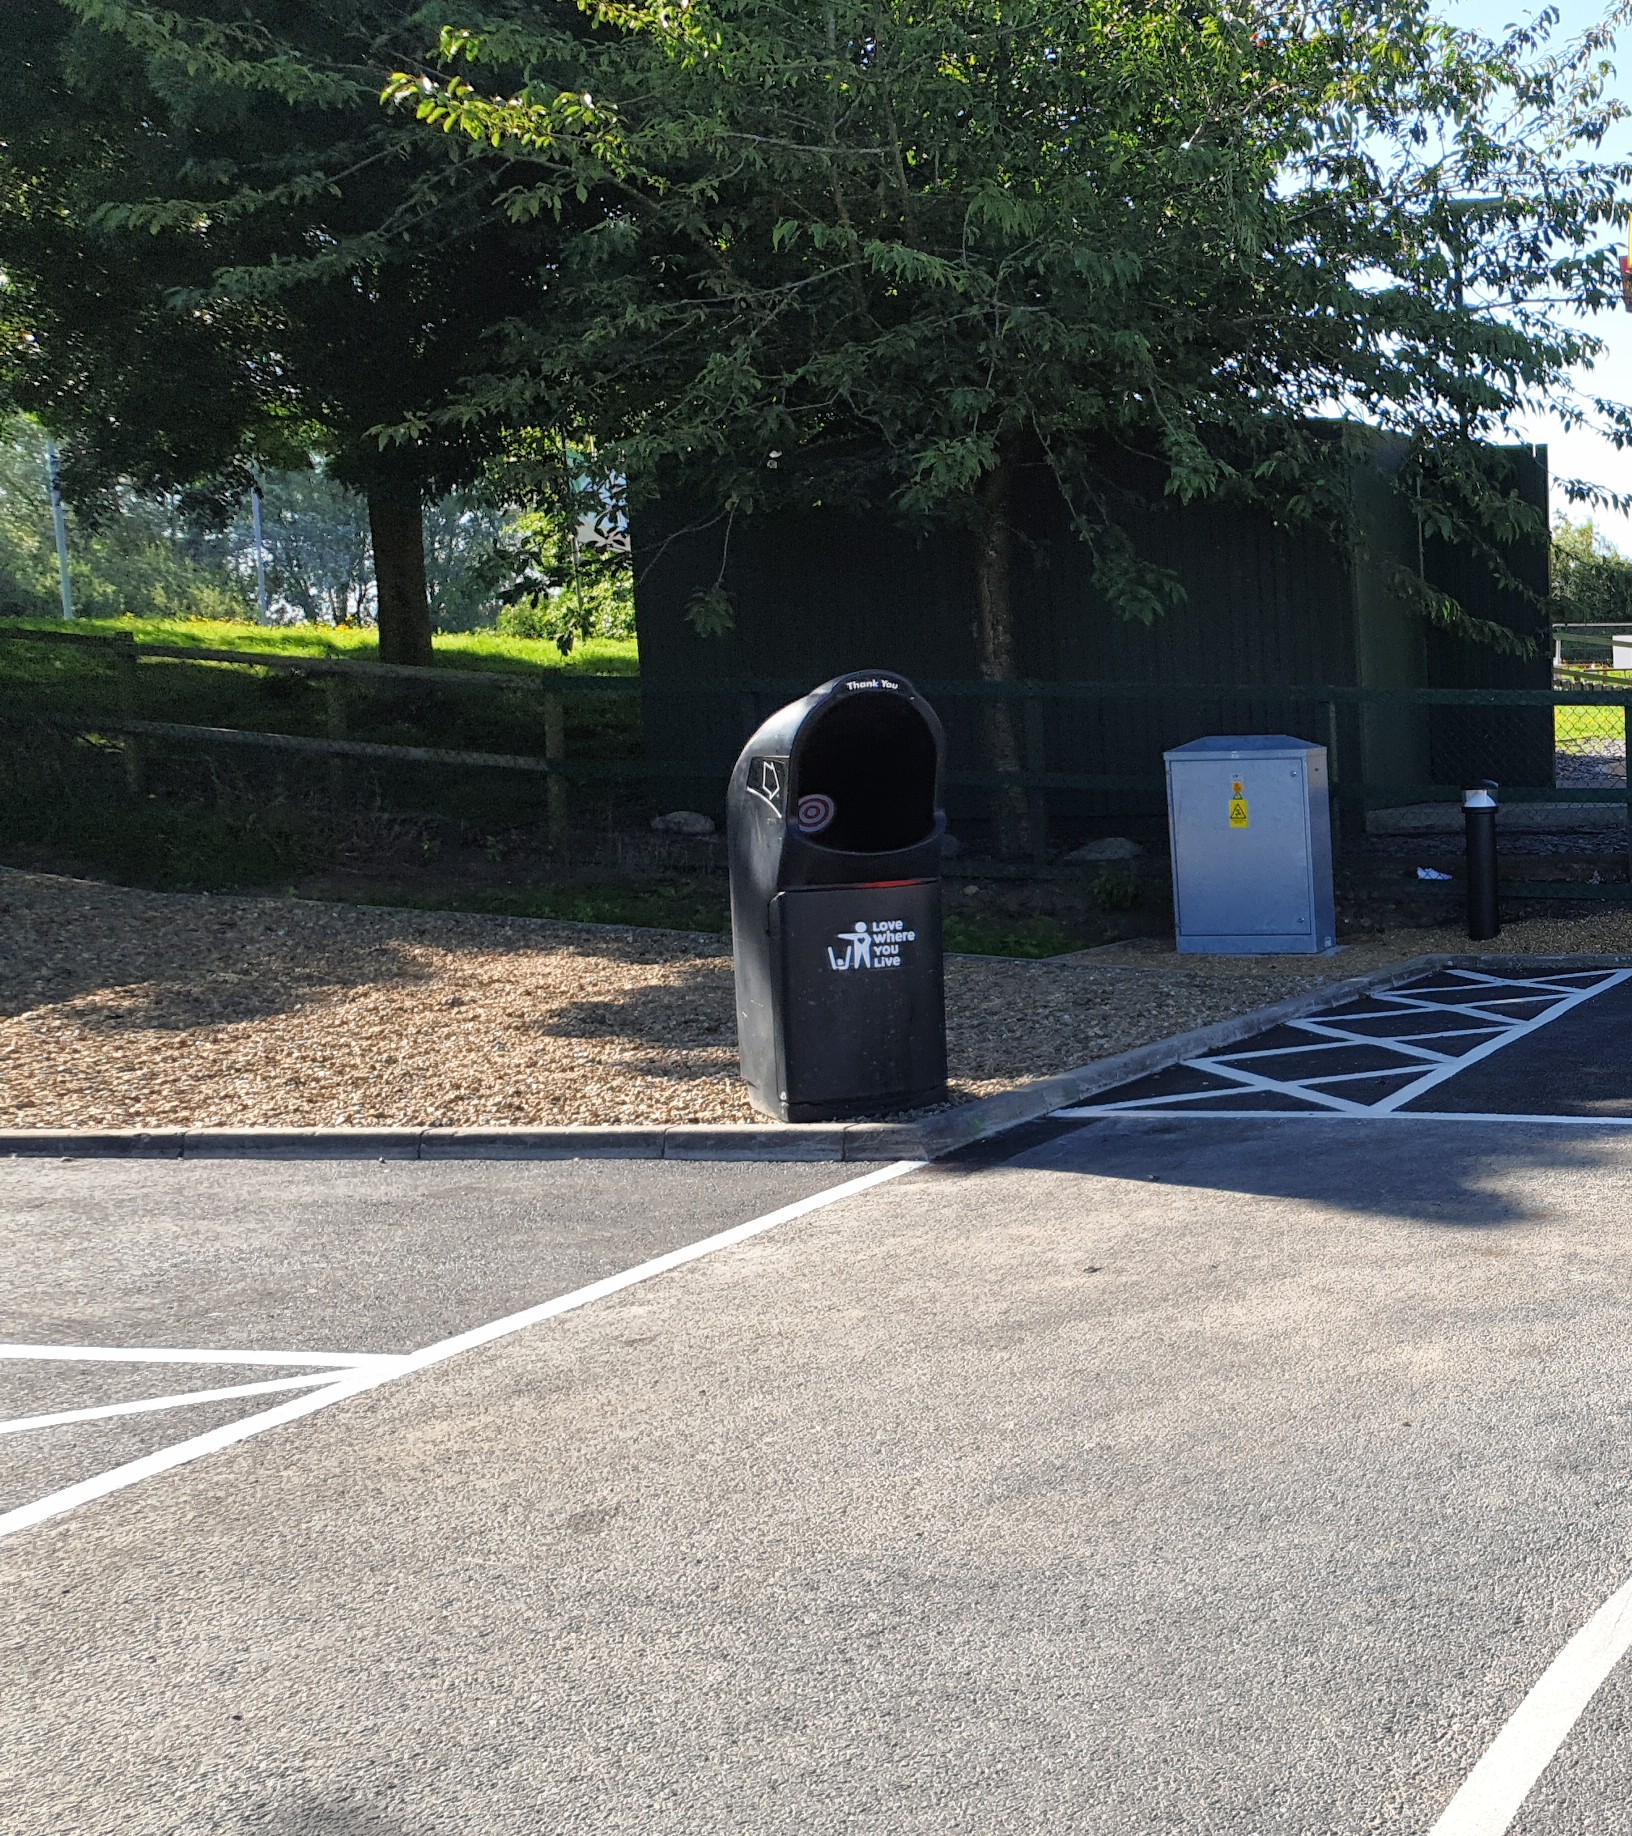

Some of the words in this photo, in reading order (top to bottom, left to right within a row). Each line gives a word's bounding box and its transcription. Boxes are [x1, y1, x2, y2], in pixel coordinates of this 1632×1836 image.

[846, 678, 879, 691] Thank
[880, 678, 899, 690] You
[872, 919, 904, 932] Love
[873, 956, 901, 968] Live
